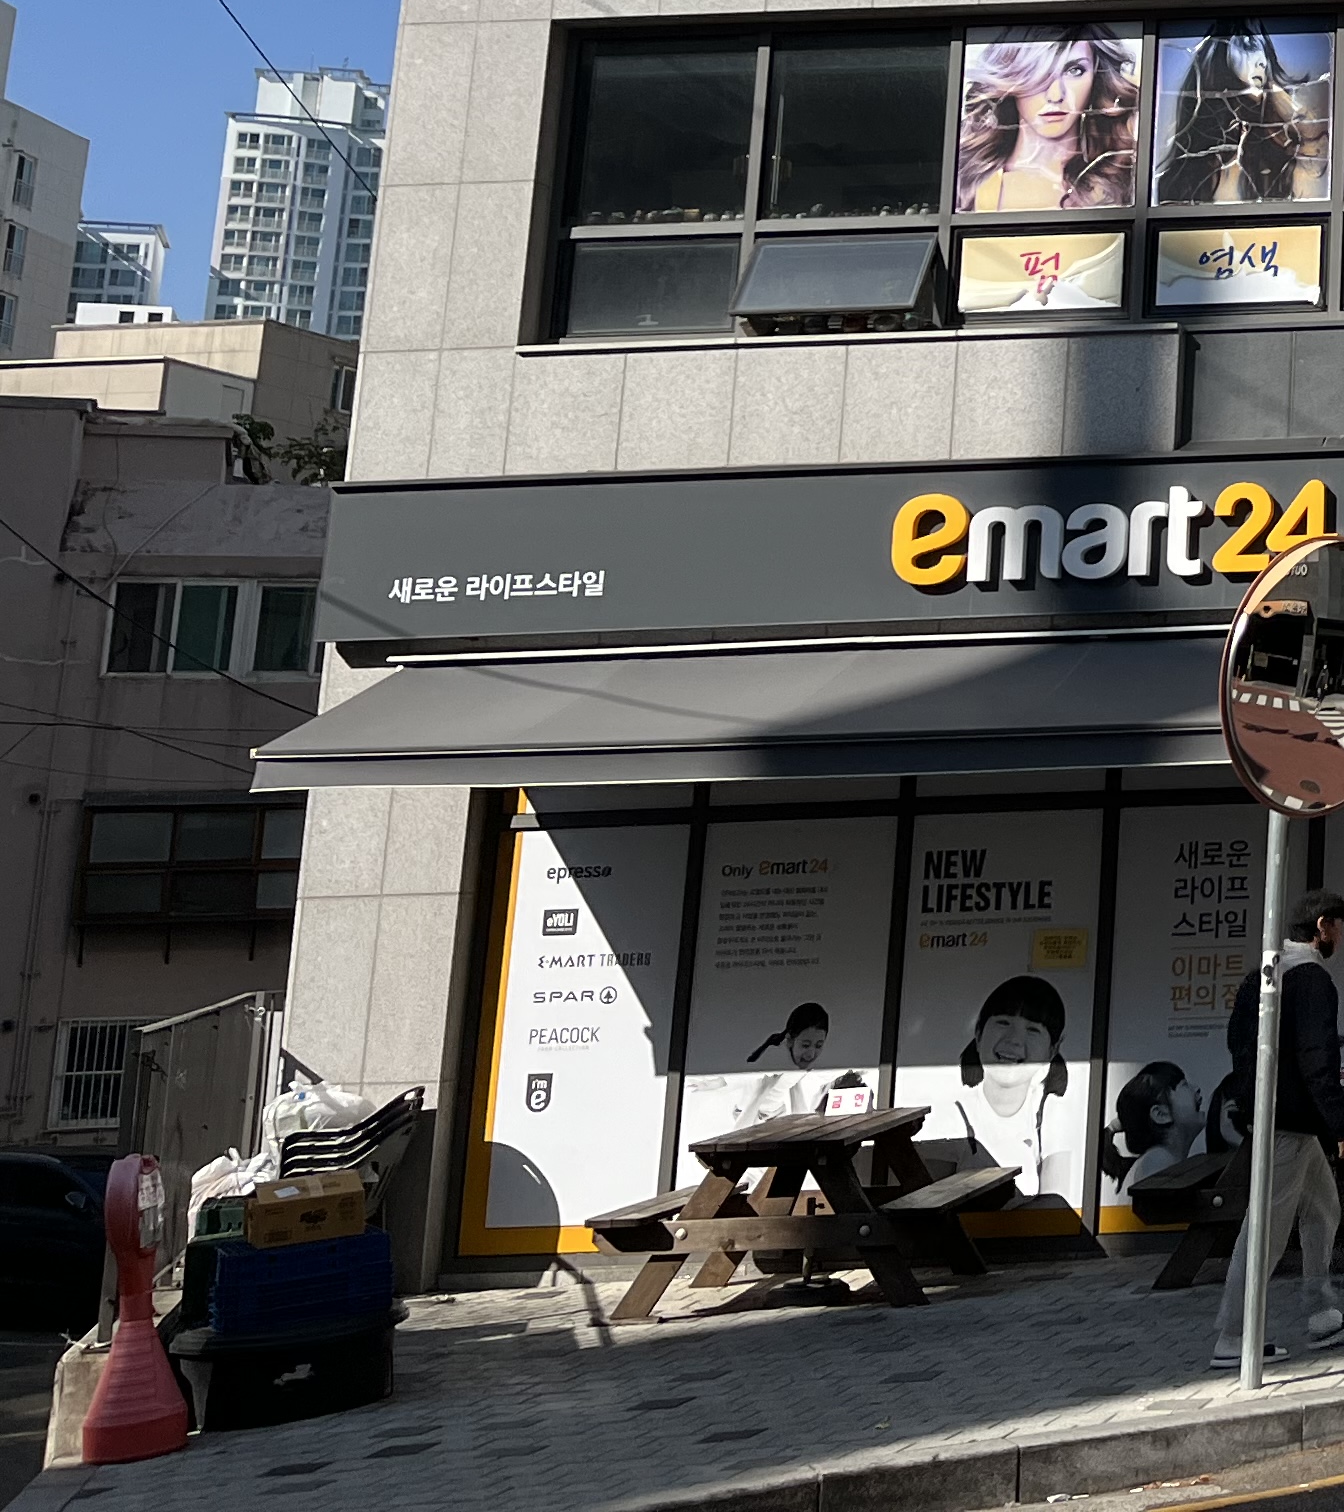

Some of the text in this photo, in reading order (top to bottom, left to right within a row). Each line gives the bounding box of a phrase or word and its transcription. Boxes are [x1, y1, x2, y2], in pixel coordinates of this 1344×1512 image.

[1021, 250, 1060, 293] 펌
[1199, 241, 1280, 280] 염색
[891, 478, 1338, 586] emart24
[389, 570, 606, 605] 새로운 라이프스타일
[923, 849, 987, 880] NEW
[1174, 840, 1251, 869] 새로운
[547, 865, 613, 885] epresso
[721, 864, 754, 879] Only
[921, 880, 1053, 914] LIFESTYLE
[1174, 875, 1250, 905] 라이프
[1171, 909, 1247, 938] 스타일
[1172, 953, 1246, 981] 이마트
[533, 991, 595, 1004] SPAR
[529, 1027, 601, 1045] PEACOCK
